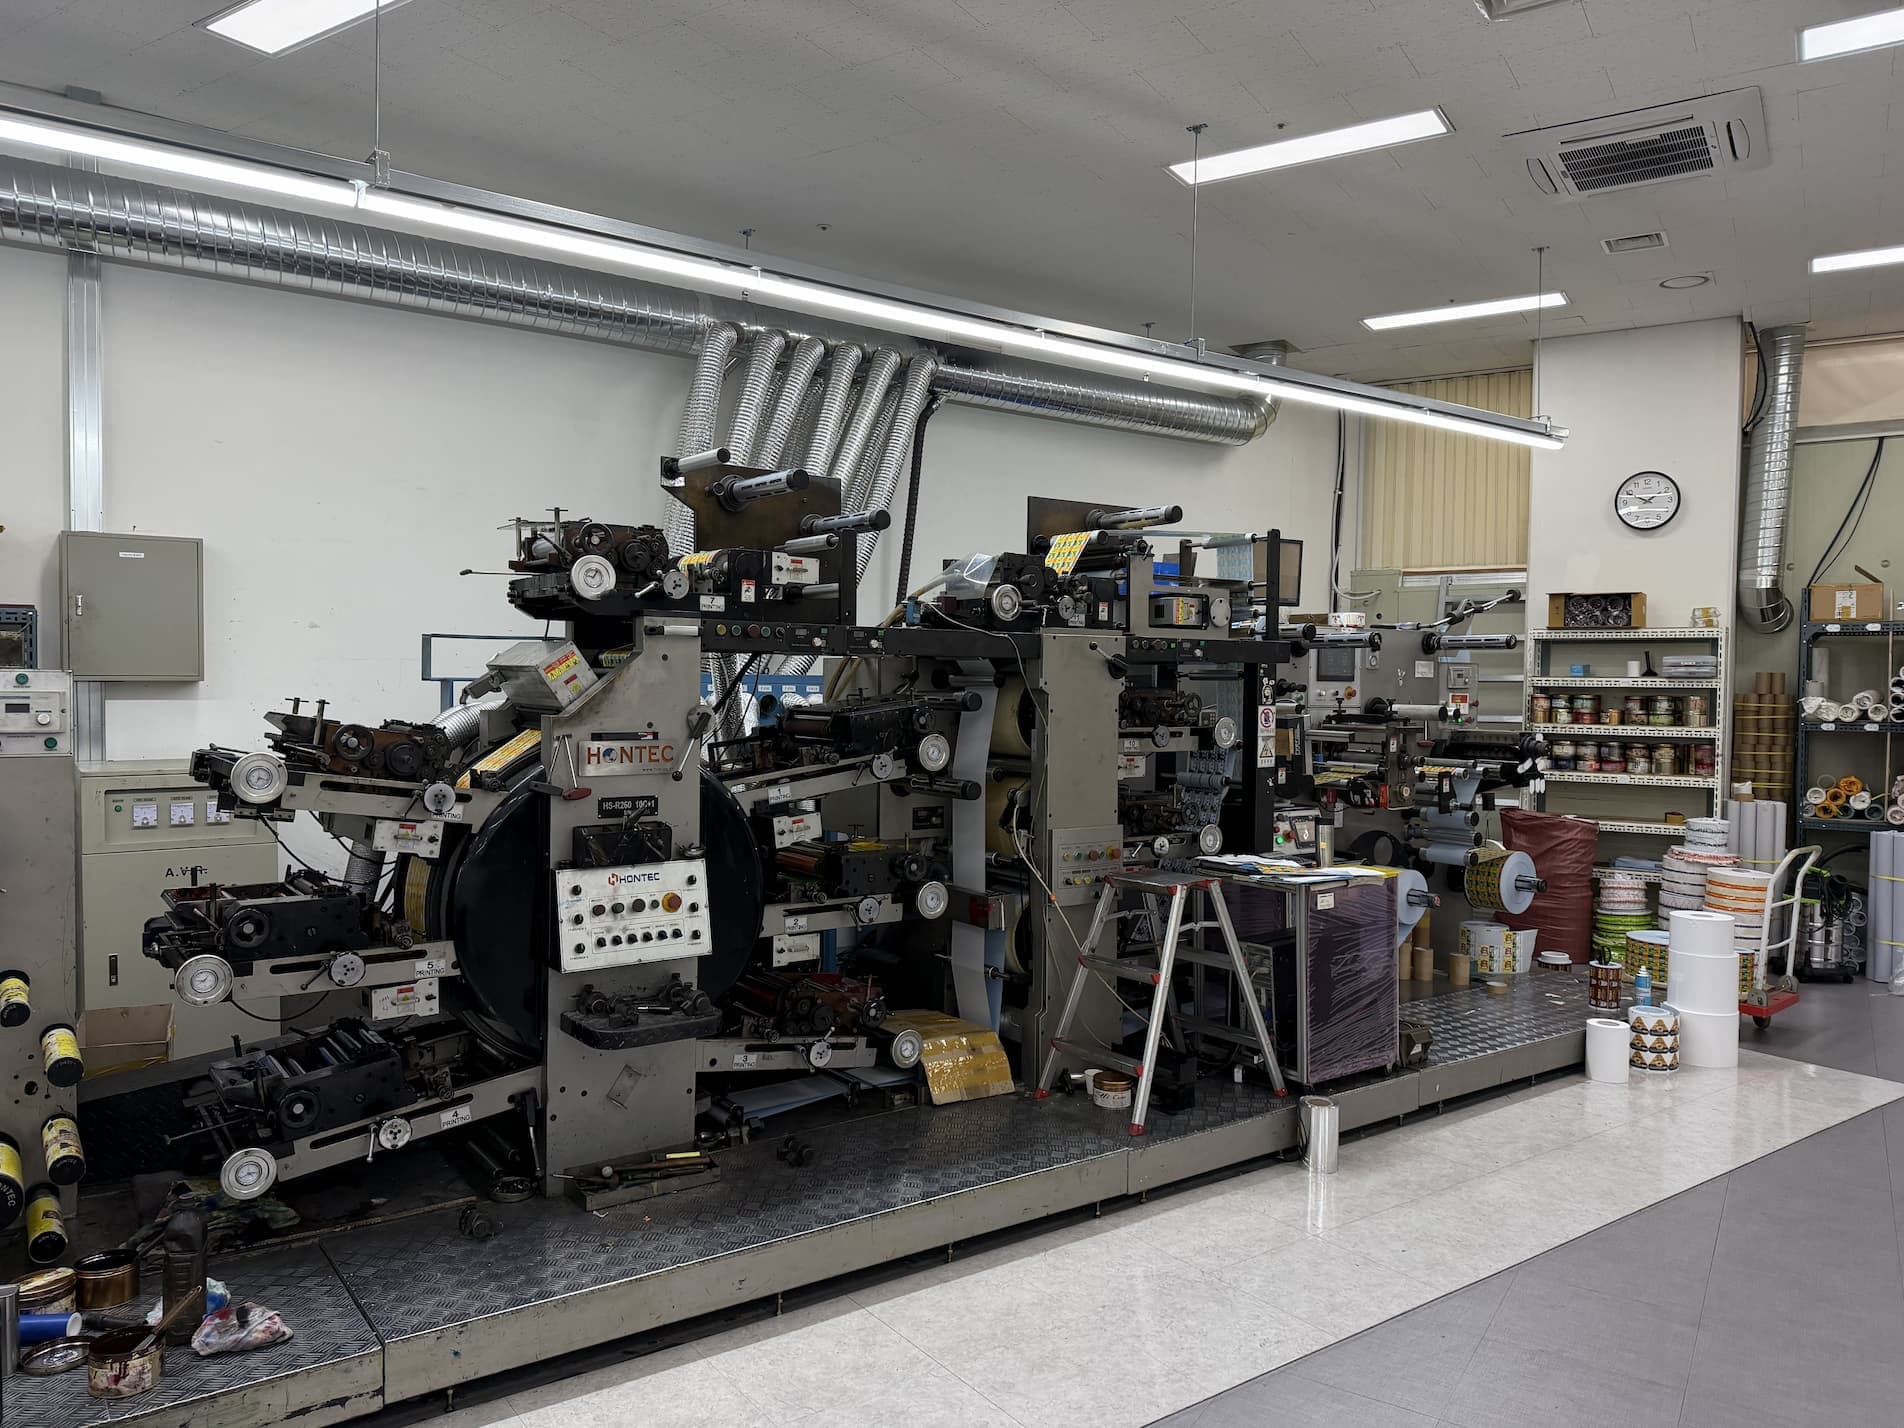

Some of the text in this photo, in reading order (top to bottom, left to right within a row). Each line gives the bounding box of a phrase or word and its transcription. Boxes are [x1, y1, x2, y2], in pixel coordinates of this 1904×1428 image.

[587, 745, 674, 765] HONTEC
[619, 872, 660, 884] HONTEC
[427, 961, 434, 969] 5
[415, 967, 445, 977] PRINTING
[452, 1110, 459, 1118] 4
